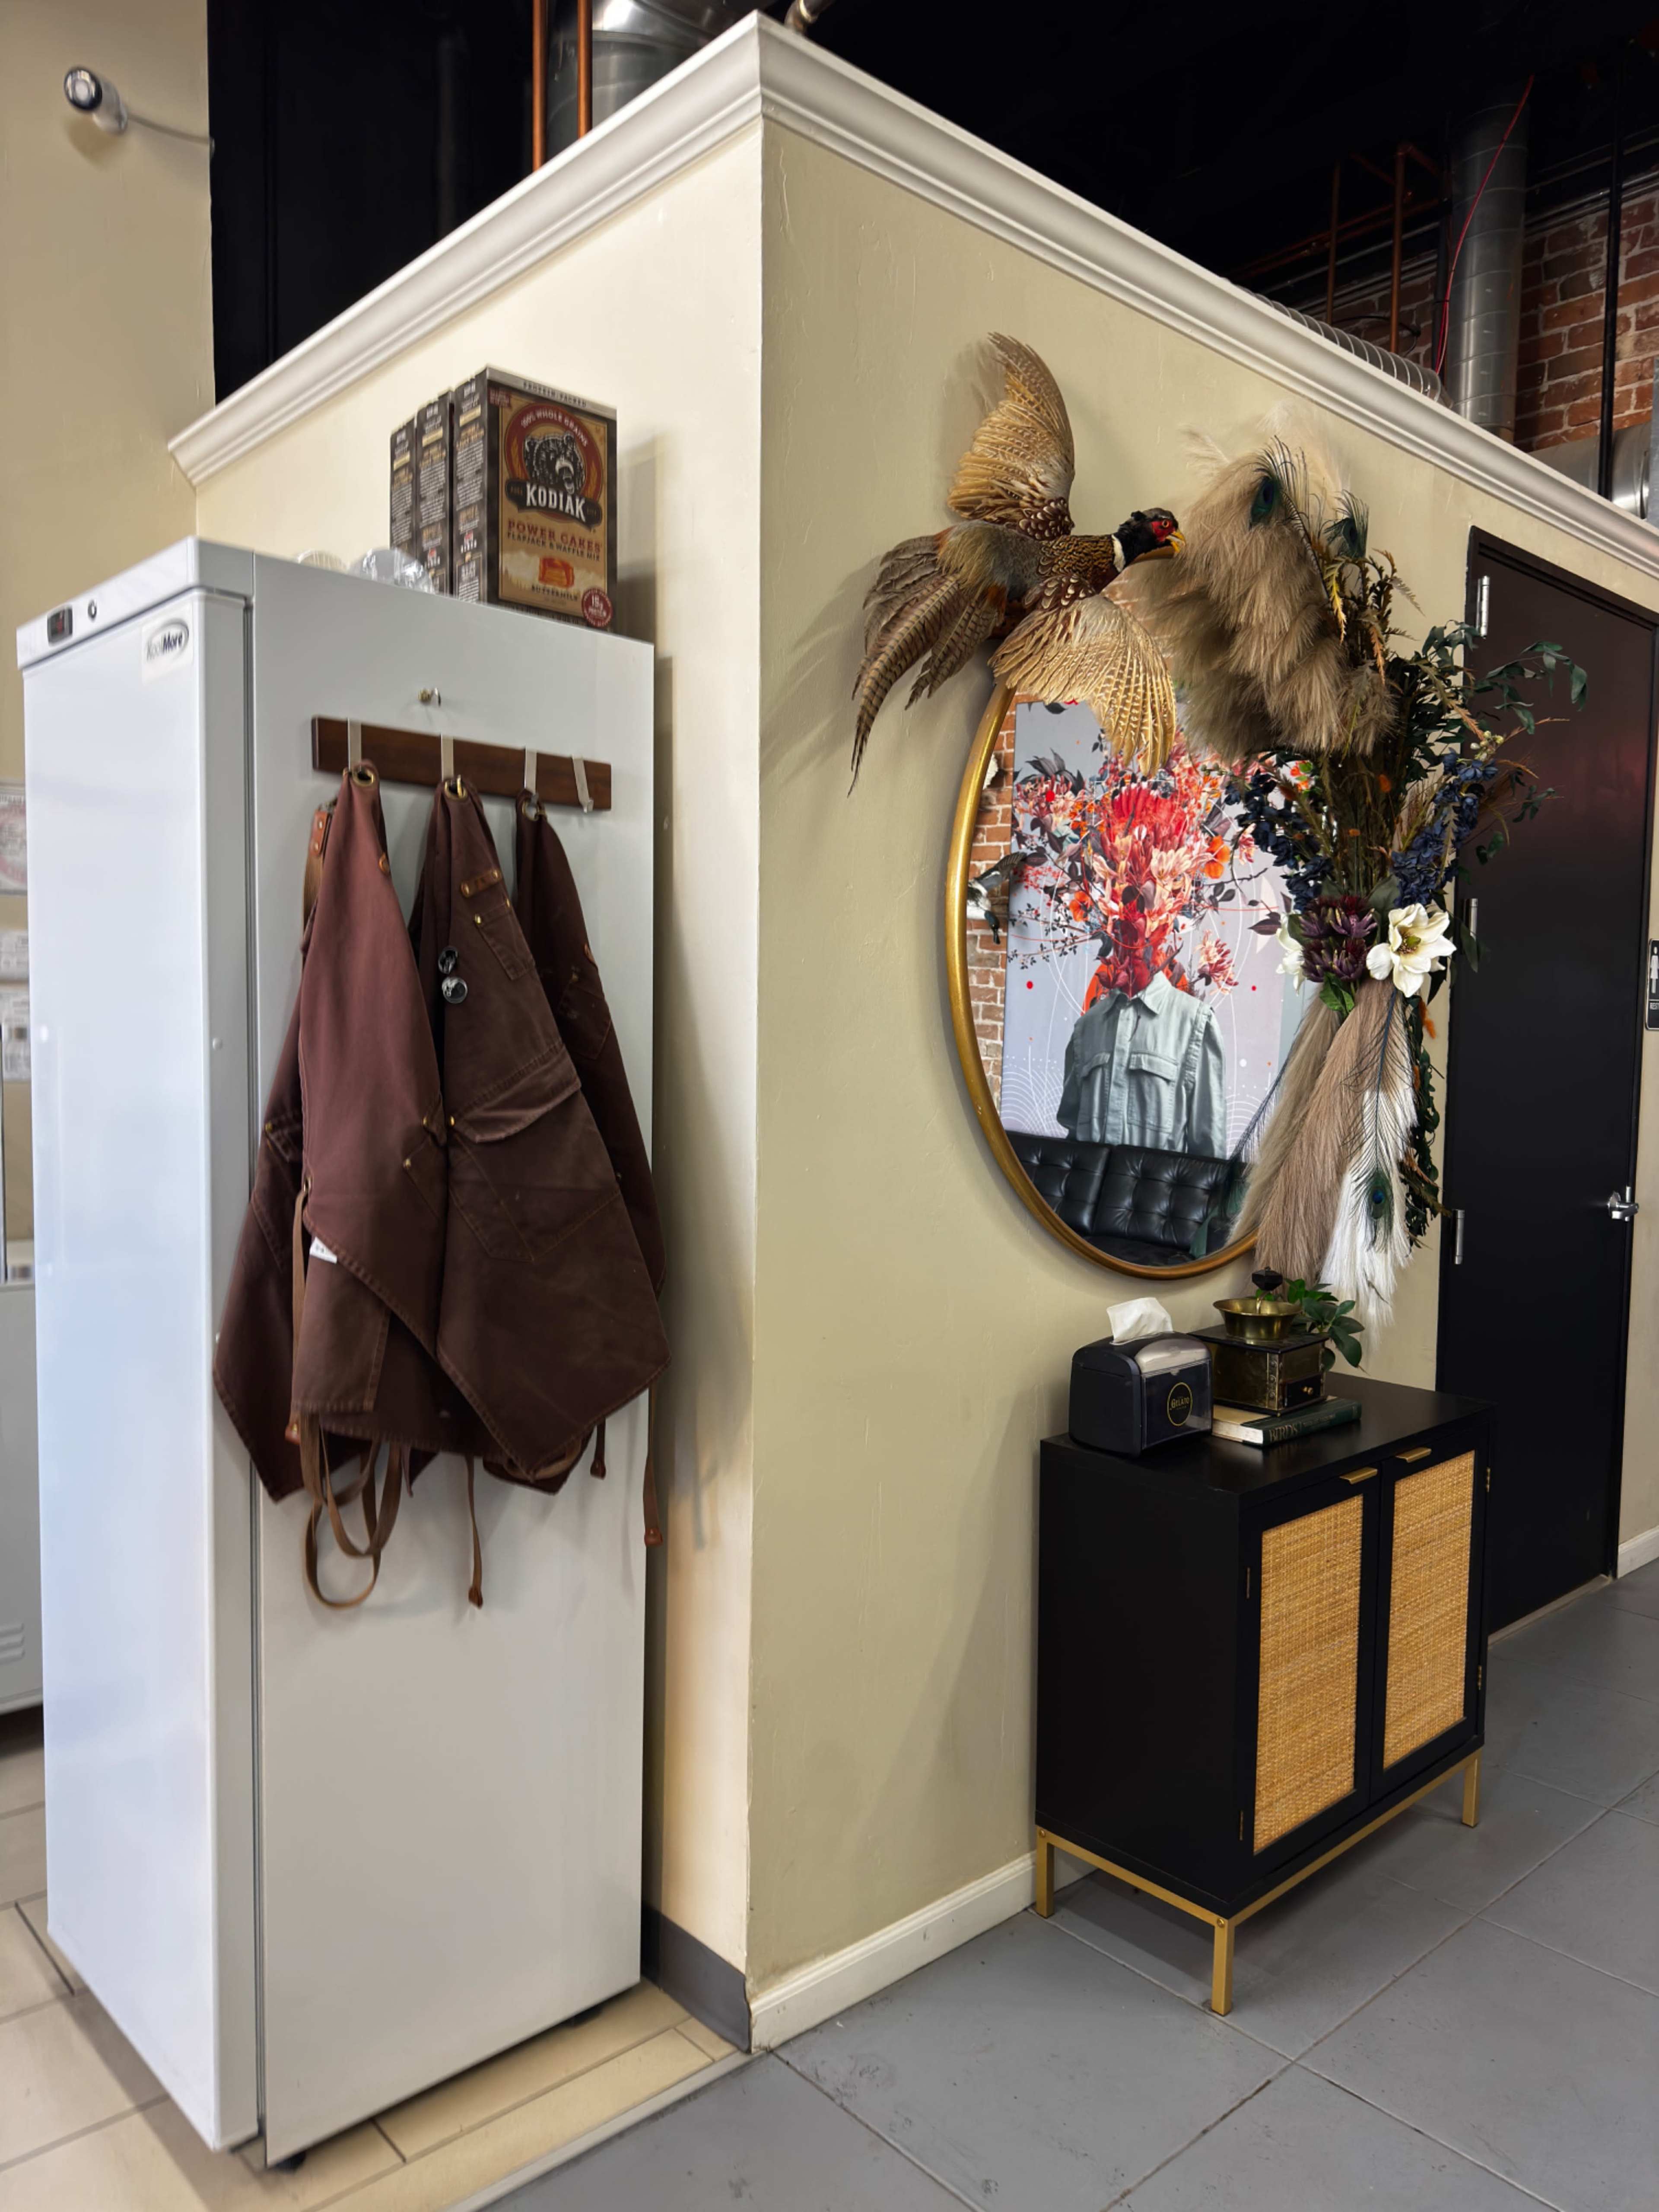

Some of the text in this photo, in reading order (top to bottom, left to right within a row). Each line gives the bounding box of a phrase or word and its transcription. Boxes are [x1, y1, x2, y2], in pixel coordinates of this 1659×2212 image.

[521, 409, 588, 447] 100% WHOLE GRAINS
[526, 482, 585, 522] KODIAK
[507, 531, 546, 548] FLAPJACK
[556, 543, 584, 557] WAFFLE
[587, 553, 600, 561] MIX
[508, 519, 601, 553] POWER CAKES
[532, 584, 578, 601] BUTTERMILK
[1269, 1422, 1299, 1443] BIRDS
